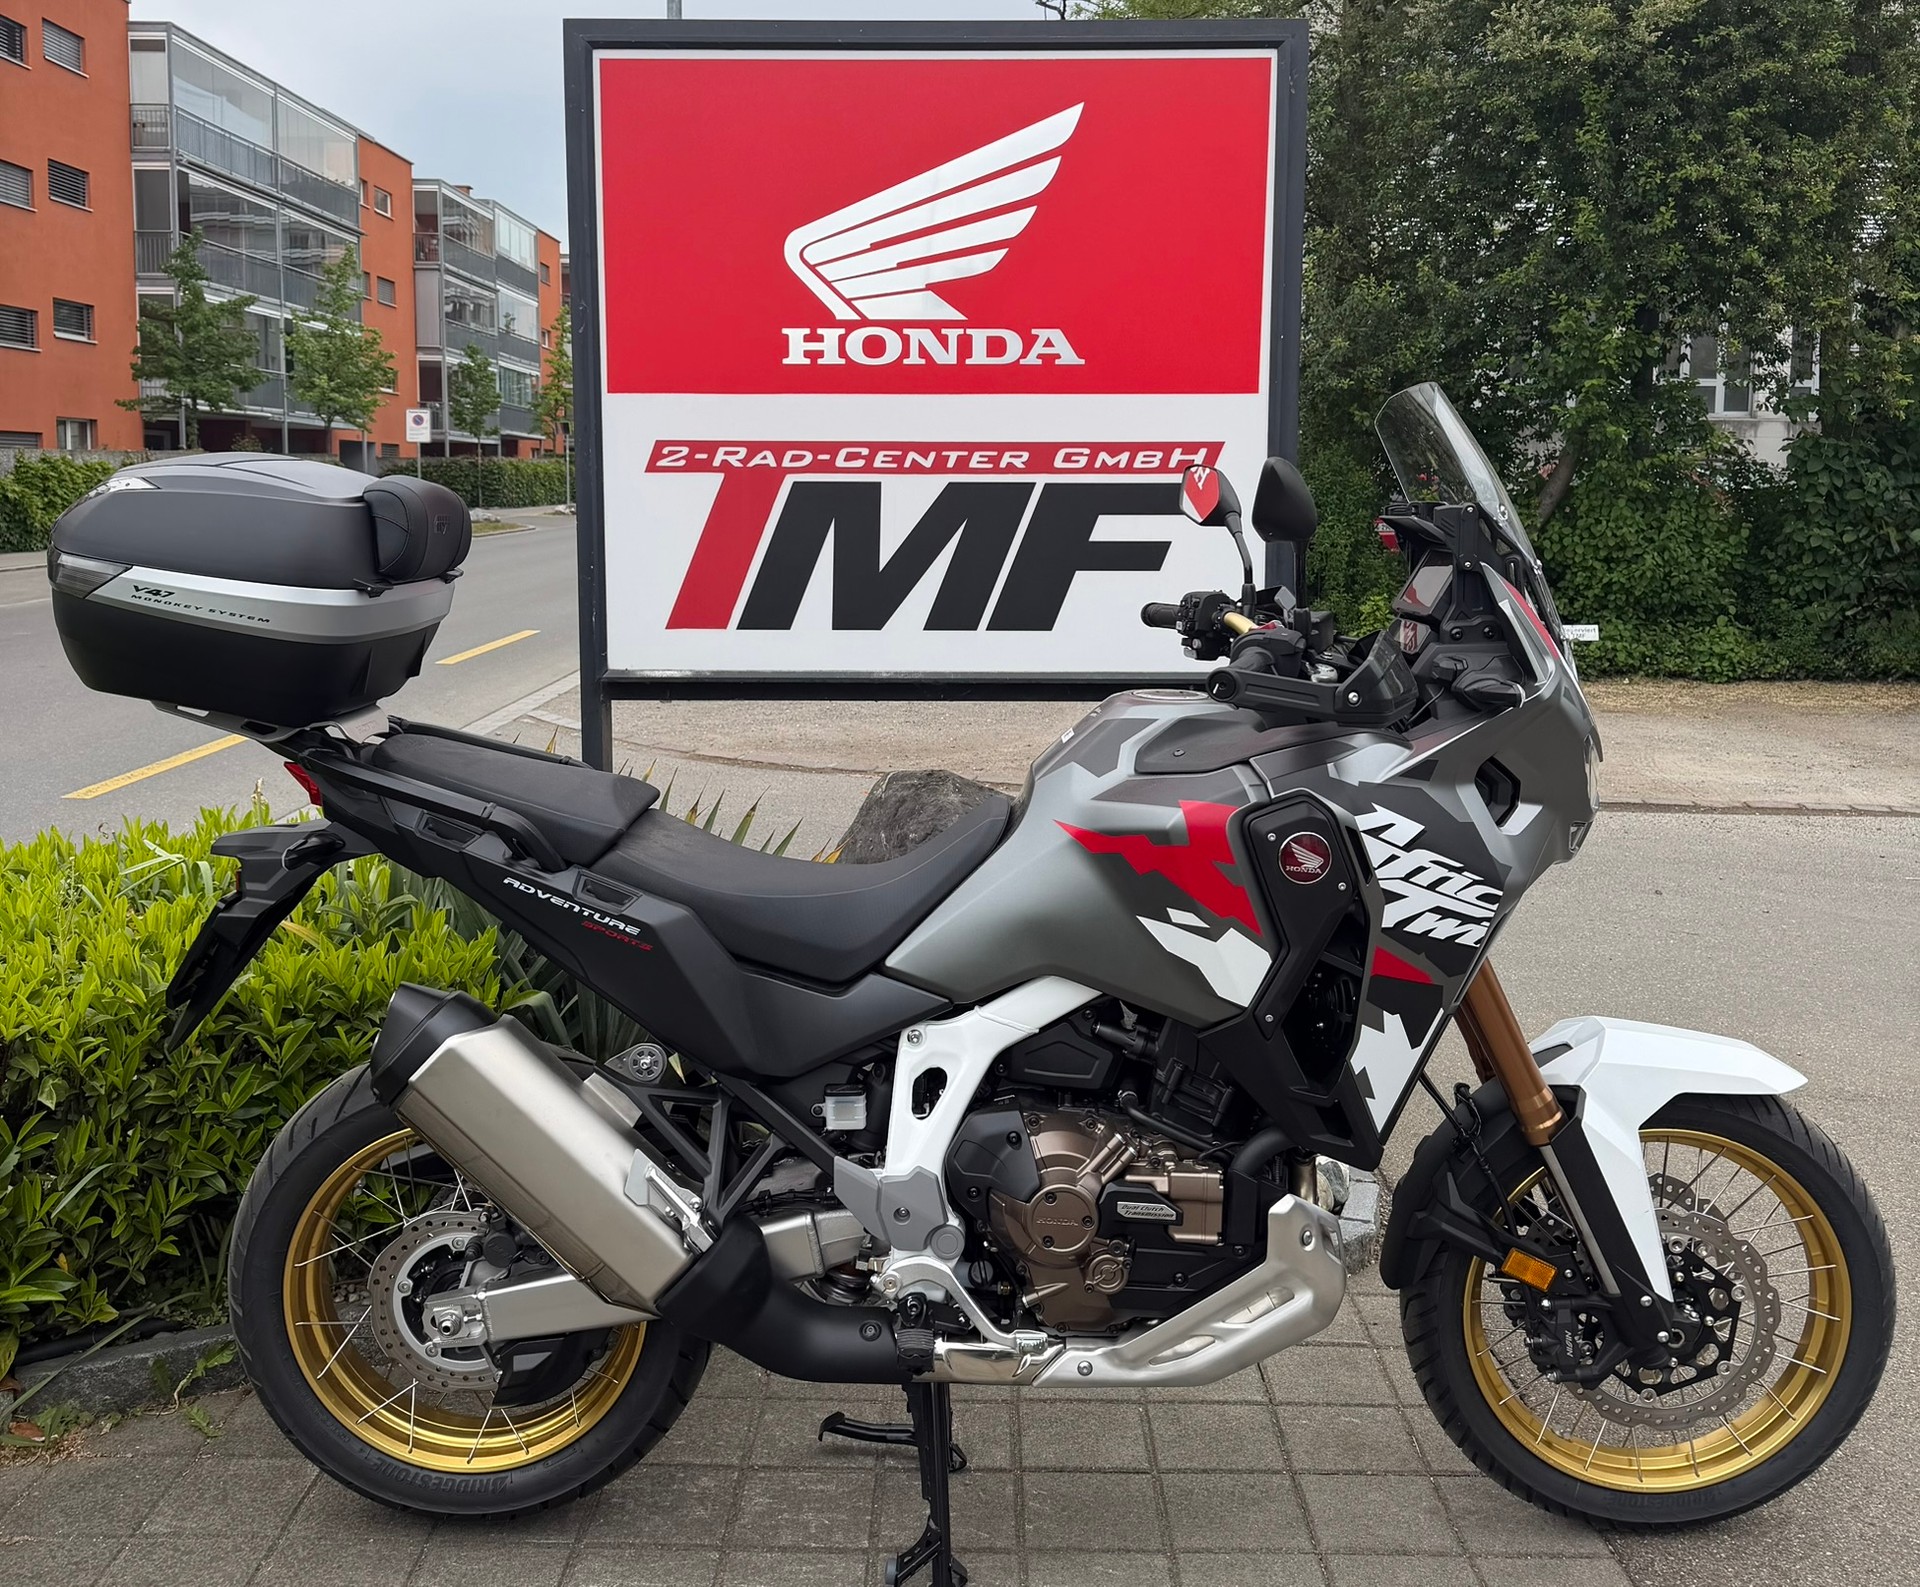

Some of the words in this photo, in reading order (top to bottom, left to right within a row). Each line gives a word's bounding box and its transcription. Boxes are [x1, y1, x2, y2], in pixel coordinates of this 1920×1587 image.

[781, 326, 1086, 365] HONDA
[645, 440, 1225, 631] TMF
[132, 584, 176, 598] V47
[130, 594, 203, 611] MONOKEY
[208, 607, 270, 623] SYSTEM
[1285, 865, 1322, 874] HONDA
[502, 876, 642, 936] ADVENTURE
[581, 920, 654, 951] SPORTS
[1036, 1217, 1079, 1227] HONDA
[1124, 1210, 1175, 1218] Transmission
[369, 1457, 510, 1495] BRIDGESTONE
